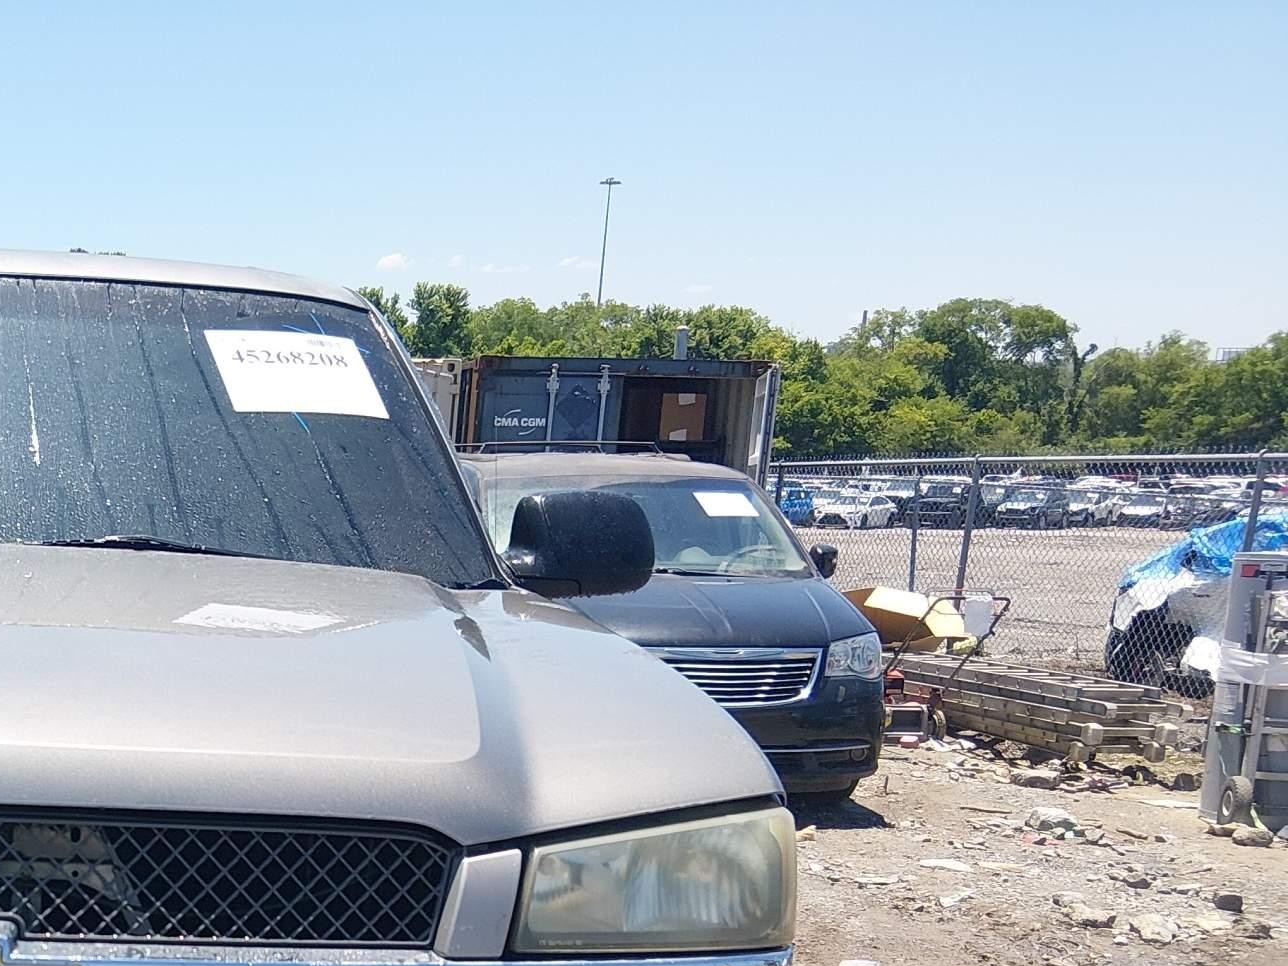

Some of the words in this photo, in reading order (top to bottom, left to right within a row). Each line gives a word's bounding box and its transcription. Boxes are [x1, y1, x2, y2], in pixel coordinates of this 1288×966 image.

[231, 349, 349, 368] 45268208
[494, 416, 519, 427] CMA
[520, 417, 546, 427] CGM
